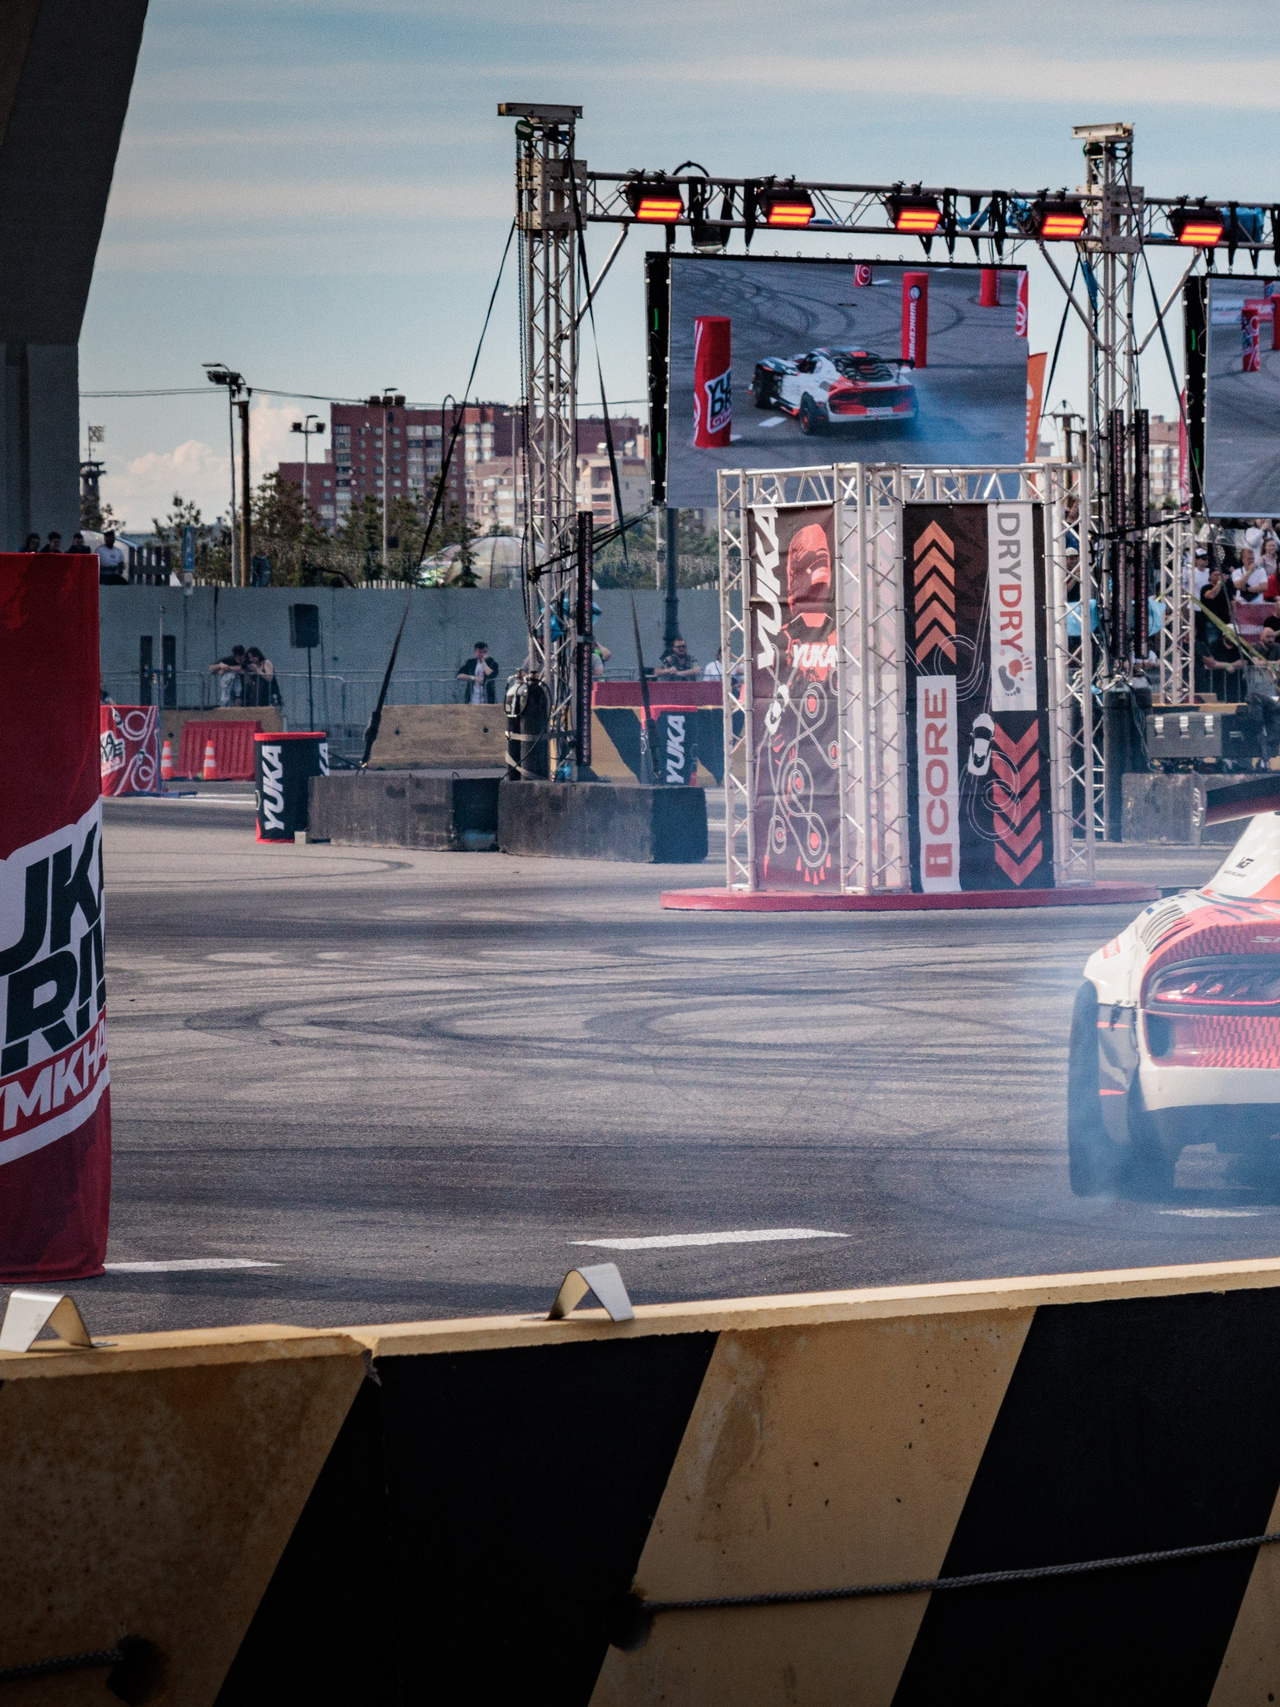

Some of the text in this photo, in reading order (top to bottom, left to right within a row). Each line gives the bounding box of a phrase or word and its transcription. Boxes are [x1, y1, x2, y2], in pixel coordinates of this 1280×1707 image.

[752, 507, 782, 669] YUKA
[997, 512, 1024, 653] DRYDRY
[792, 644, 838, 668] YUKA
[262, 745, 284, 830] YUKA
[666, 715, 685, 784] YUKA
